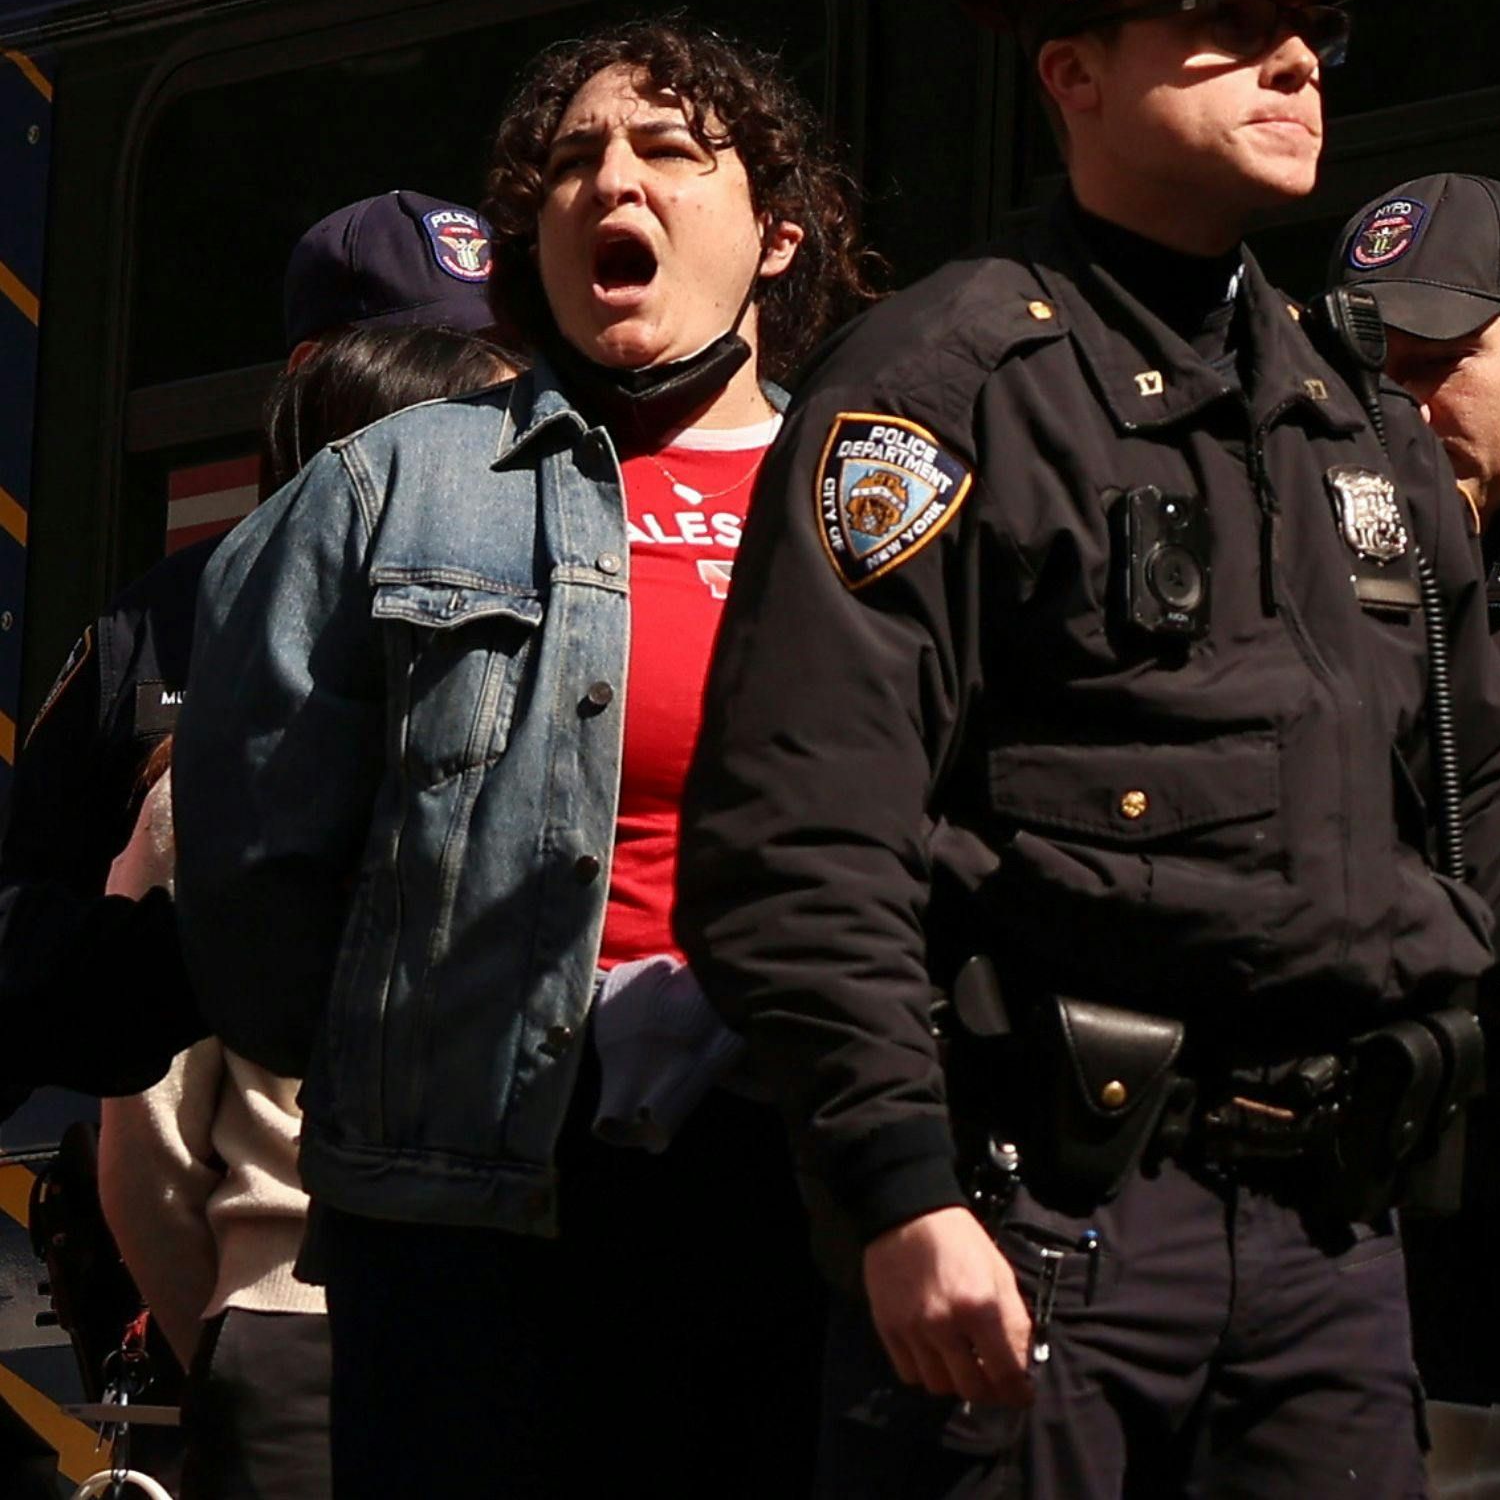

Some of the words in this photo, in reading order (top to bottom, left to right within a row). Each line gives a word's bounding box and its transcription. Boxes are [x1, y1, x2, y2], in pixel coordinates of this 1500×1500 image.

[1374, 201, 1412, 219] NYPD
[868, 425, 939, 464] POLICE
[836, 440, 953, 495] DEPARTMENT
[823, 477, 838, 522] CITY
[828, 527, 846, 551] OF
[866, 540, 902, 570] NEW
[900, 500, 947, 543] YORK
